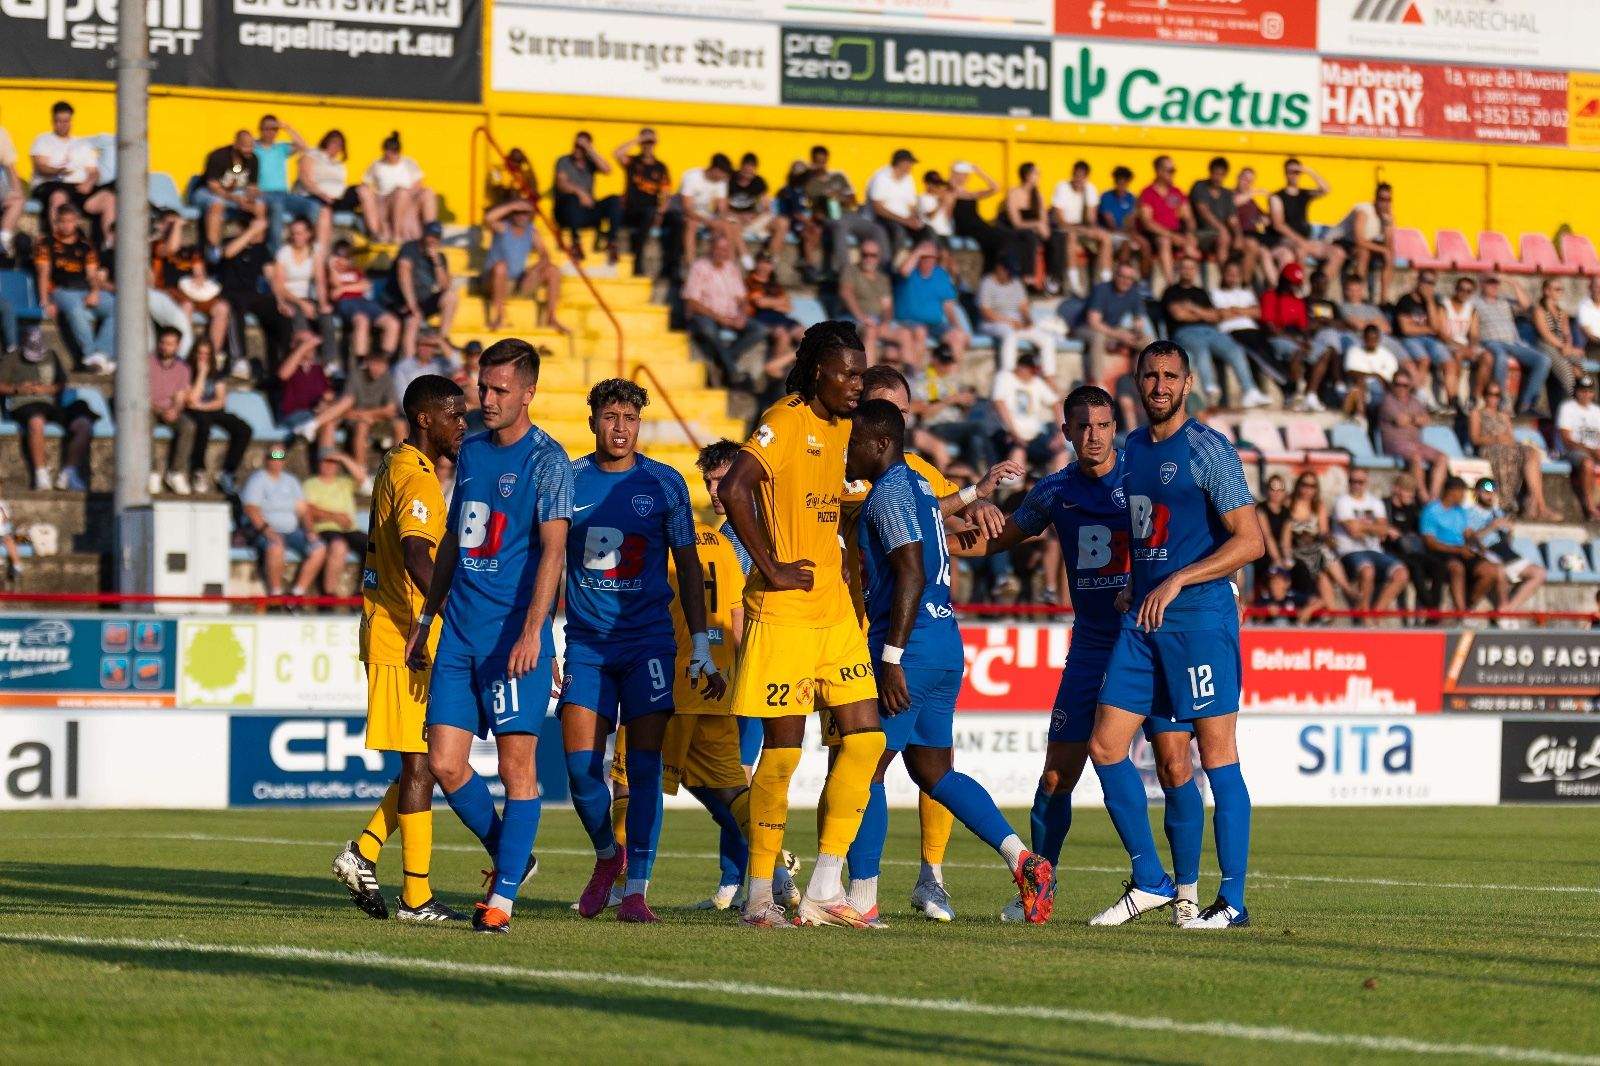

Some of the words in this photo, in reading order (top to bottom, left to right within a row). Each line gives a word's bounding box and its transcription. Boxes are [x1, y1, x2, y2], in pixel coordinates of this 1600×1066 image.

[1434, 8, 1541, 34] MARECHAL
[70, 23, 203, 55] SPRT
[239, 20, 454, 58] capellisport.eu
[508, 25, 687, 72] Luxemburger
[694, 36, 766, 68] Wort
[785, 33, 834, 58] pre
[785, 58, 851, 81] zero
[884, 38, 1049, 92] Lamesch
[1320, 62, 1424, 90] Marbrerie
[1118, 68, 1311, 129] Cactus
[1320, 86, 1424, 128] HARY
[1093, 575, 1124, 587] YOUR
[1251, 648, 1312, 671] Belval
[1312, 648, 1367, 671] Plaza
[1477, 645, 1535, 668] IPSO
[1541, 645, 1600, 668] FACT
[647, 657, 667, 691] 9
[1187, 663, 1216, 699] 12
[491, 676, 520, 715] 31
[765, 682, 791, 708] 22
[6, 720, 80, 799] al
[1526, 733, 1578, 777] Gigi
[253, 780, 307, 800] Charles
